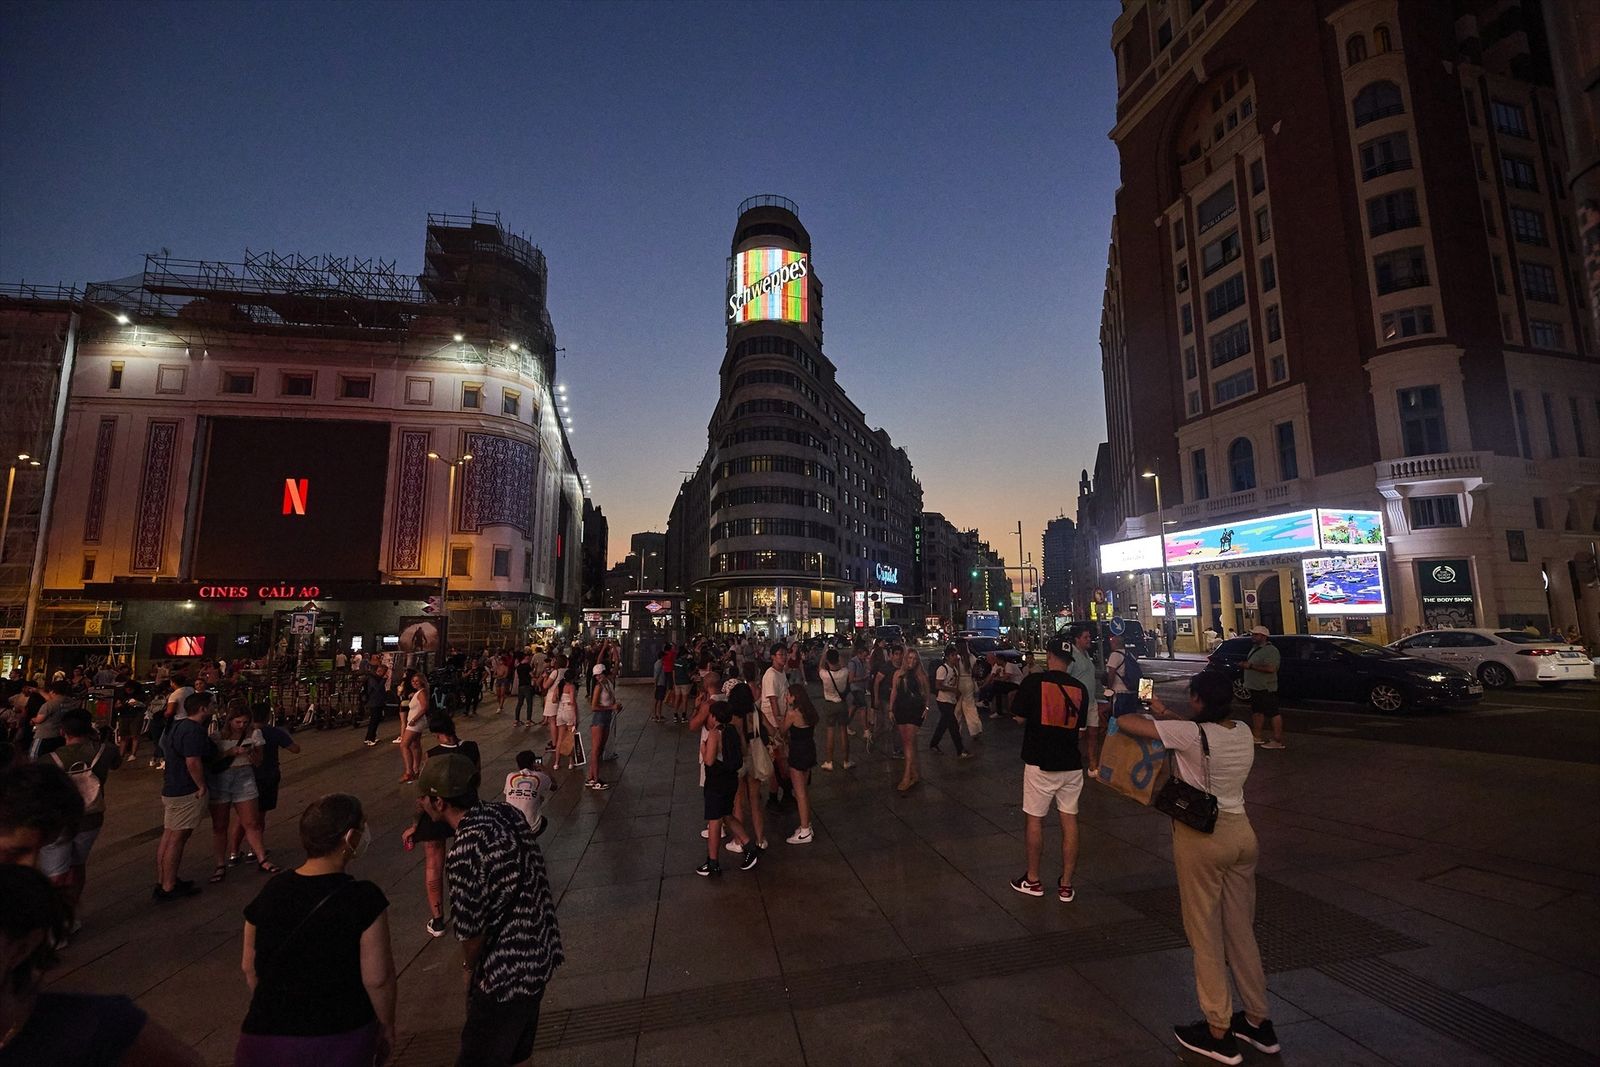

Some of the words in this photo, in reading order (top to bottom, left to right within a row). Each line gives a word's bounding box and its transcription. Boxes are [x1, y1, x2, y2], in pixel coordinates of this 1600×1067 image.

[728, 258, 807, 319] Schweppes
[282, 478, 309, 515] N
[199, 586, 248, 598] CINES
